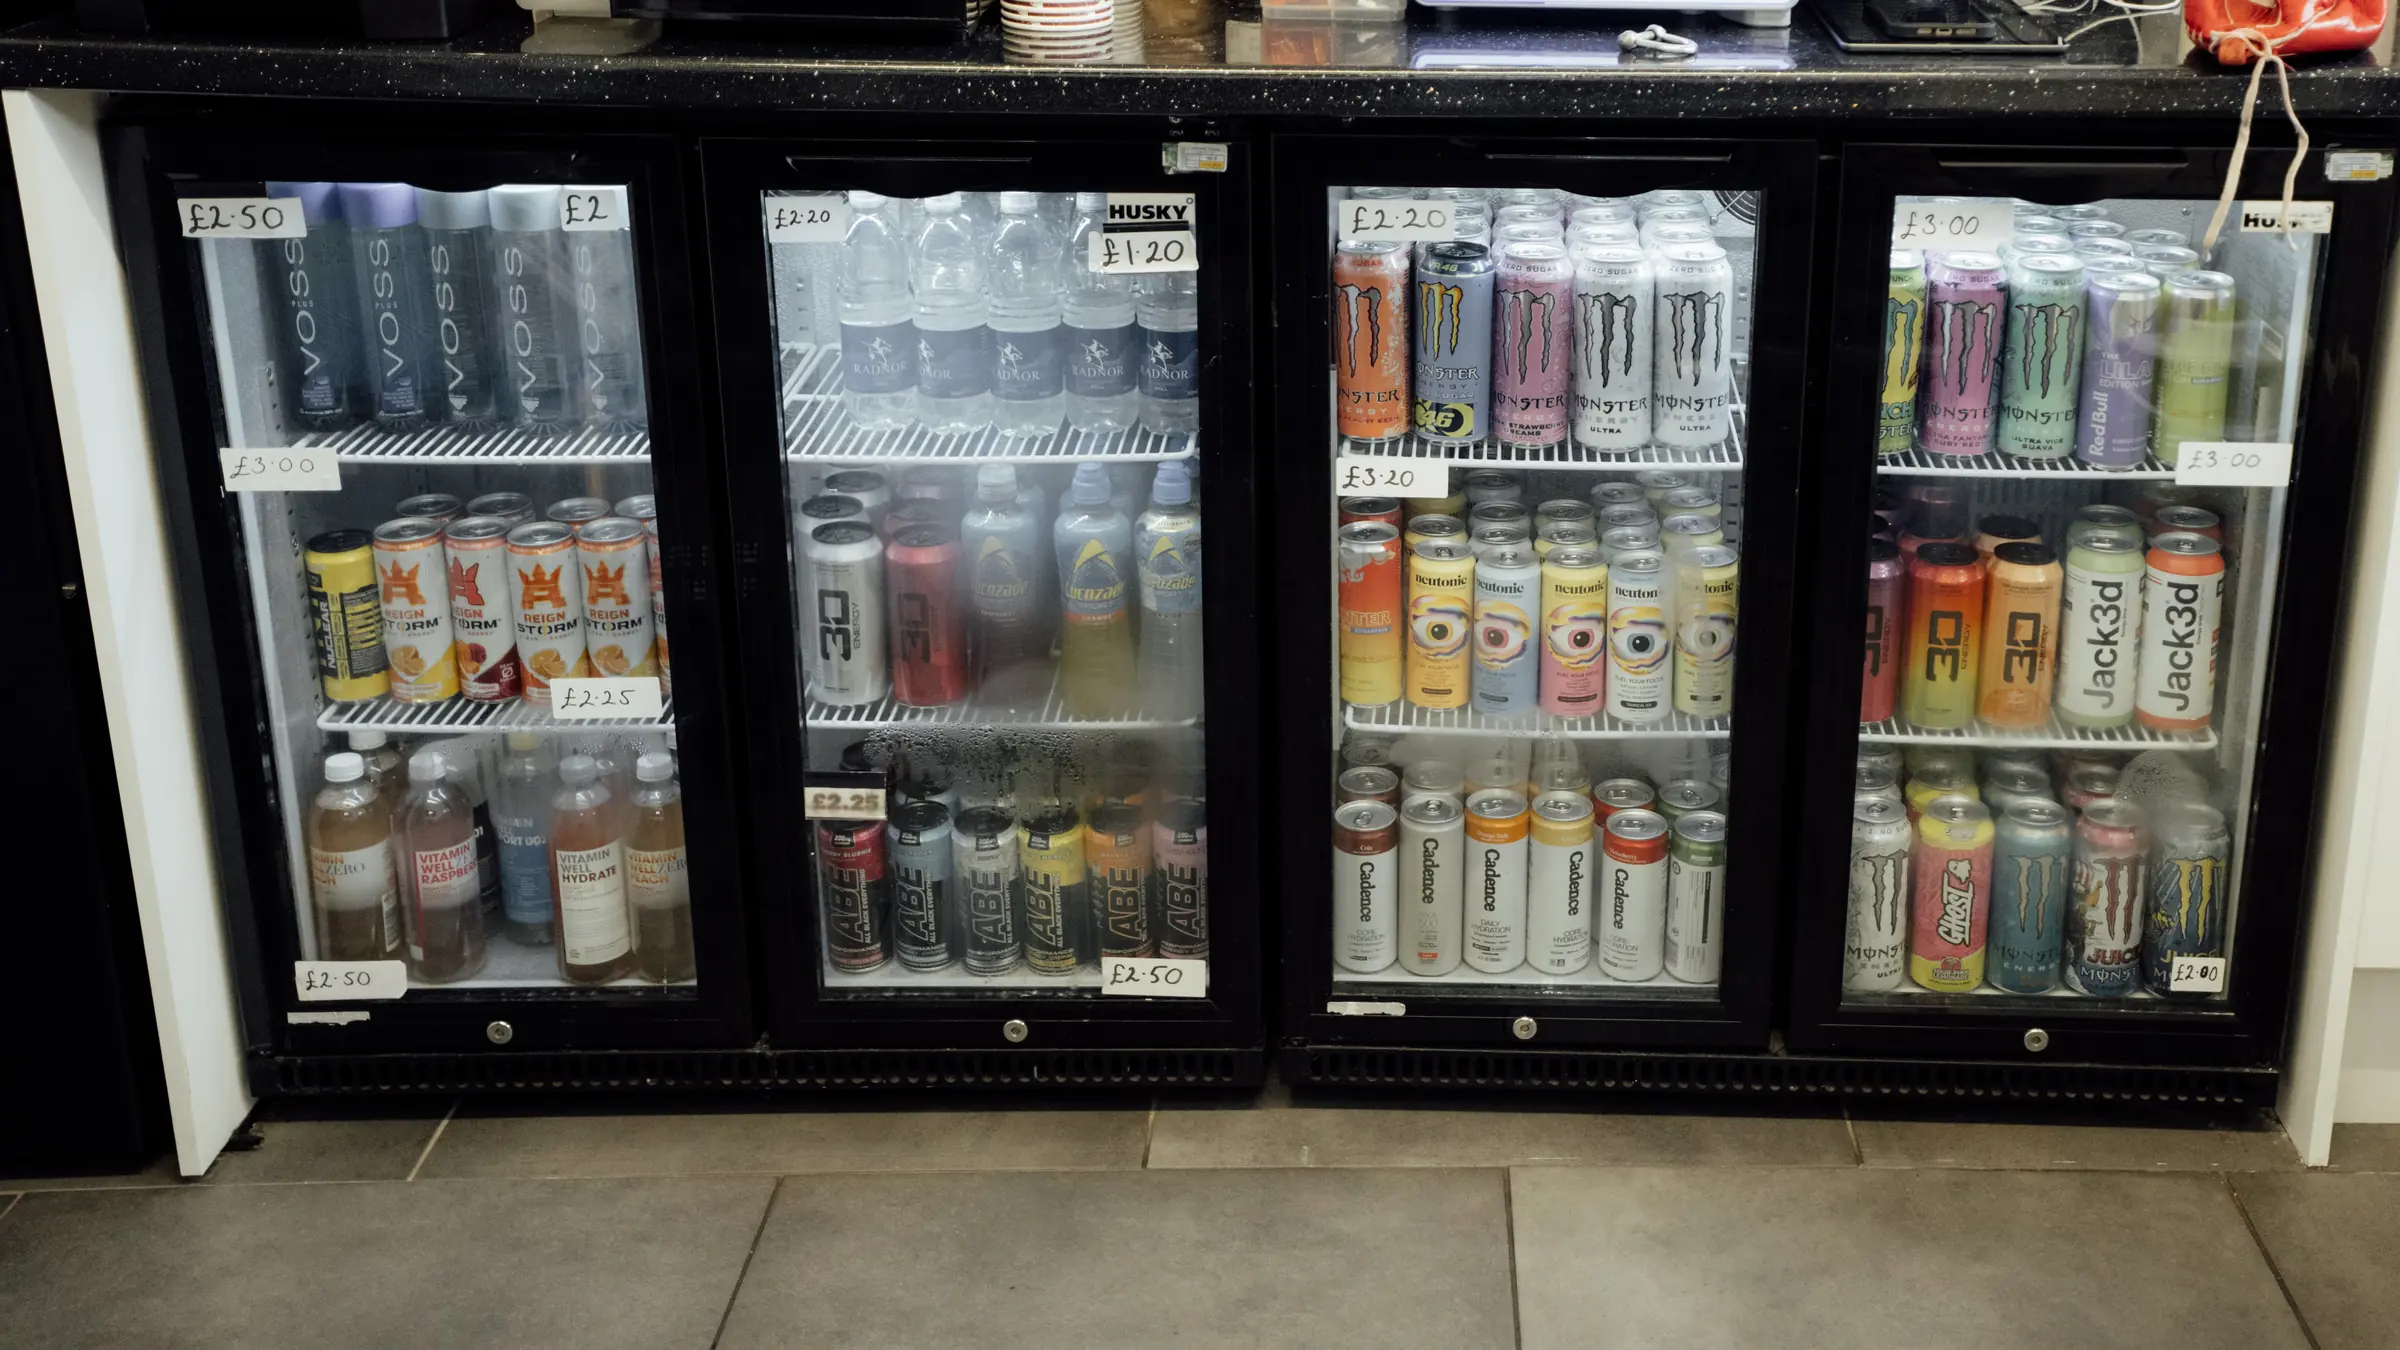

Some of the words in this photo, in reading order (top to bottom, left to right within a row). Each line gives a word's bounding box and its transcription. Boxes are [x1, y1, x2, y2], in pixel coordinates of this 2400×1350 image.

[566, 194, 608, 224] £2
[1109, 204, 1188, 220] HUSKY
[1502, 261, 1522, 271] ZERO
[370, 238, 404, 377] VOSS
[431, 245, 464, 391] VOSS
[505, 247, 536, 393] VOSS
[1072, 365, 1125, 378] RADNOR
[1418, 363, 1480, 380] ONSTER
[2100, 360, 2151, 379] LILA
[2099, 378, 2139, 389] EDITION
[1340, 387, 1400, 404] NSTER
[1576, 395, 1648, 414] MONSTER
[1590, 426, 1622, 434] ULTRA
[1415, 573, 1468, 587] neutonic
[1476, 577, 1524, 594] neutonic
[1555, 580, 1606, 594] neutonic
[1704, 580, 1734, 594] tonic
[1615, 586, 1658, 599] neuton
[523, 611, 566, 623] REIGN
[590, 608, 629, 620] REIGN
[517, 618, 579, 636] STORM
[585, 617, 643, 633] STORM
[818, 589, 851, 662] 3D
[852, 602, 861, 650] ENERGY
[320, 601, 337, 669] NUCLEAR
[1926, 610, 1963, 682] 3D
[2003, 611, 2041, 684] 3D
[2038, 624, 2048, 672] ENERGY
[2083, 580, 2123, 710] Jack3d
[2158, 581, 2199, 712] Jack3d
[813, 793, 880, 812] £2.25
[419, 843, 470, 864] VITAMIN
[559, 848, 610, 864] VITAMIN
[628, 851, 677, 865] VITAMIN
[326, 862, 366, 876] ZERO
[421, 863, 454, 874] WELL
[561, 862, 590, 874] WELL
[562, 865, 618, 884] HYDRATE
[1422, 837, 1440, 904] Cadence
[859, 868, 869, 911] EVERYTHING
[1484, 849, 1501, 912] Cadence
[1568, 850, 1584, 916] Cadence
[1166, 862, 1200, 938] ABE
[1359, 861, 1376, 922] Cadence
[1613, 868, 1630, 930] Cadence
[827, 863, 864, 943] ABE
[895, 862, 929, 941] ABE
[969, 866, 1007, 944] ABE
[1024, 864, 1056, 946] ABE
[1107, 866, 1142, 940] ABE
[1937, 871, 1975, 948] GHOST
[1471, 924, 1511, 934] HYDRATION
[1480, 918, 1500, 927] DAILY
[1056, 937, 1064, 948] ALL
[2003, 961, 2056, 973] ENERG
